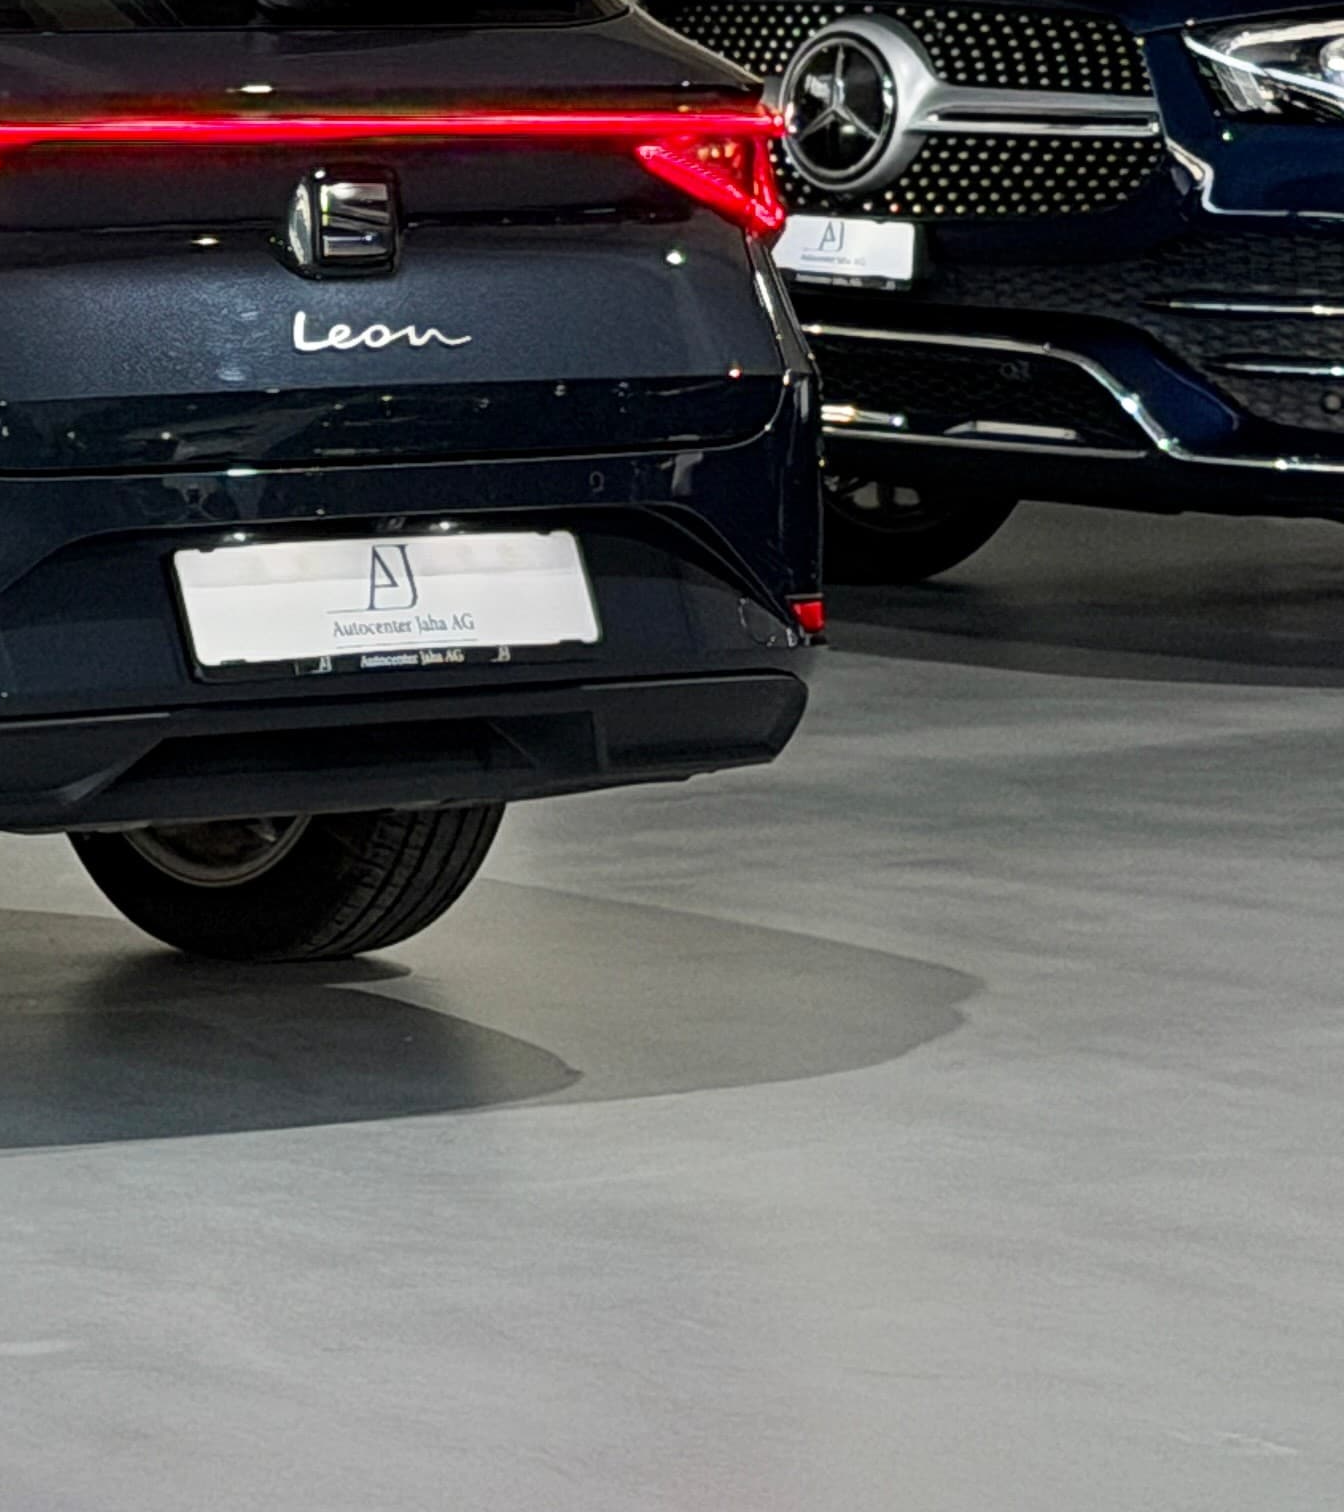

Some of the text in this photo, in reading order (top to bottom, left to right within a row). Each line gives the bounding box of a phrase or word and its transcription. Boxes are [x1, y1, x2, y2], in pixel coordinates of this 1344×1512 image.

[293, 311, 473, 352] Leon
[367, 543, 419, 611] AJ
[333, 612, 475, 638] Autocenter Jaha AG
